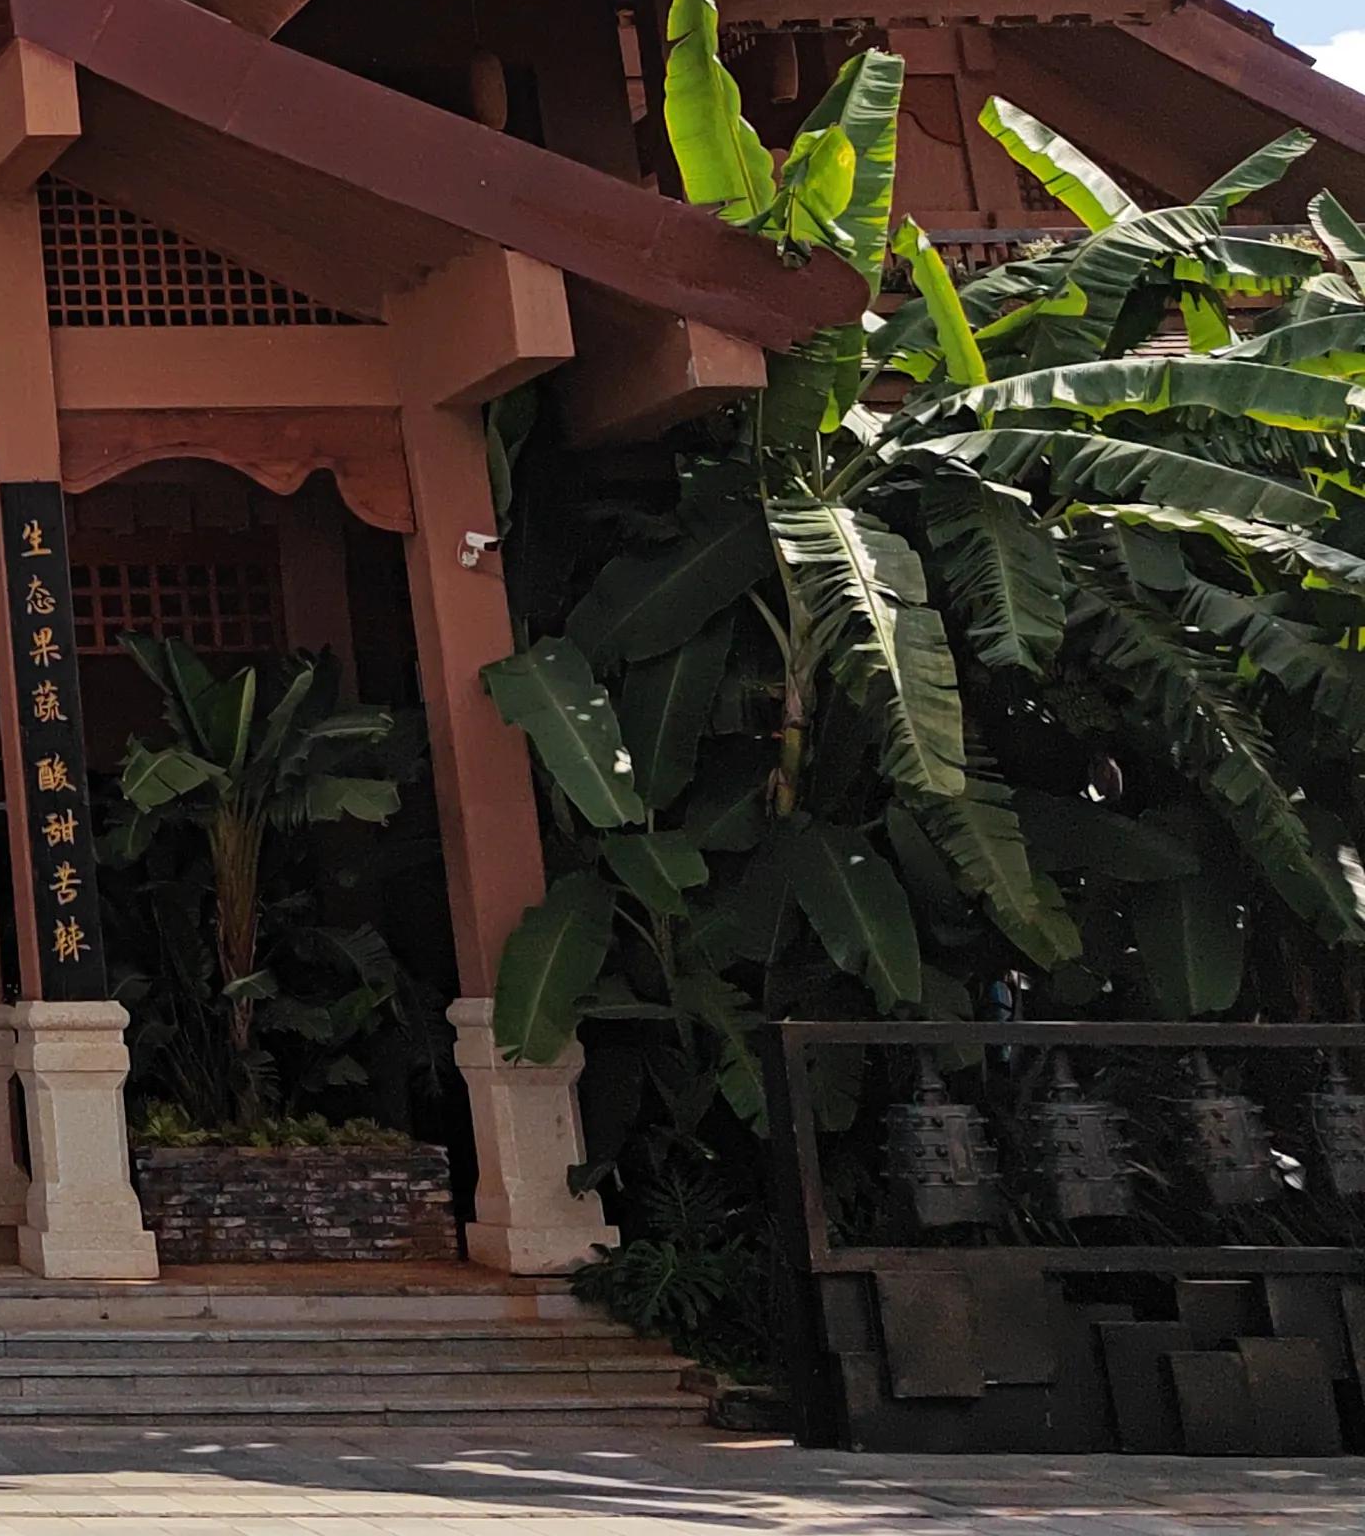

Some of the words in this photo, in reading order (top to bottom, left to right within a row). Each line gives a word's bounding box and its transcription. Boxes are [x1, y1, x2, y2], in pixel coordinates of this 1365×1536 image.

[21, 519, 91, 964] 生态果蔬酸甜苦辣
